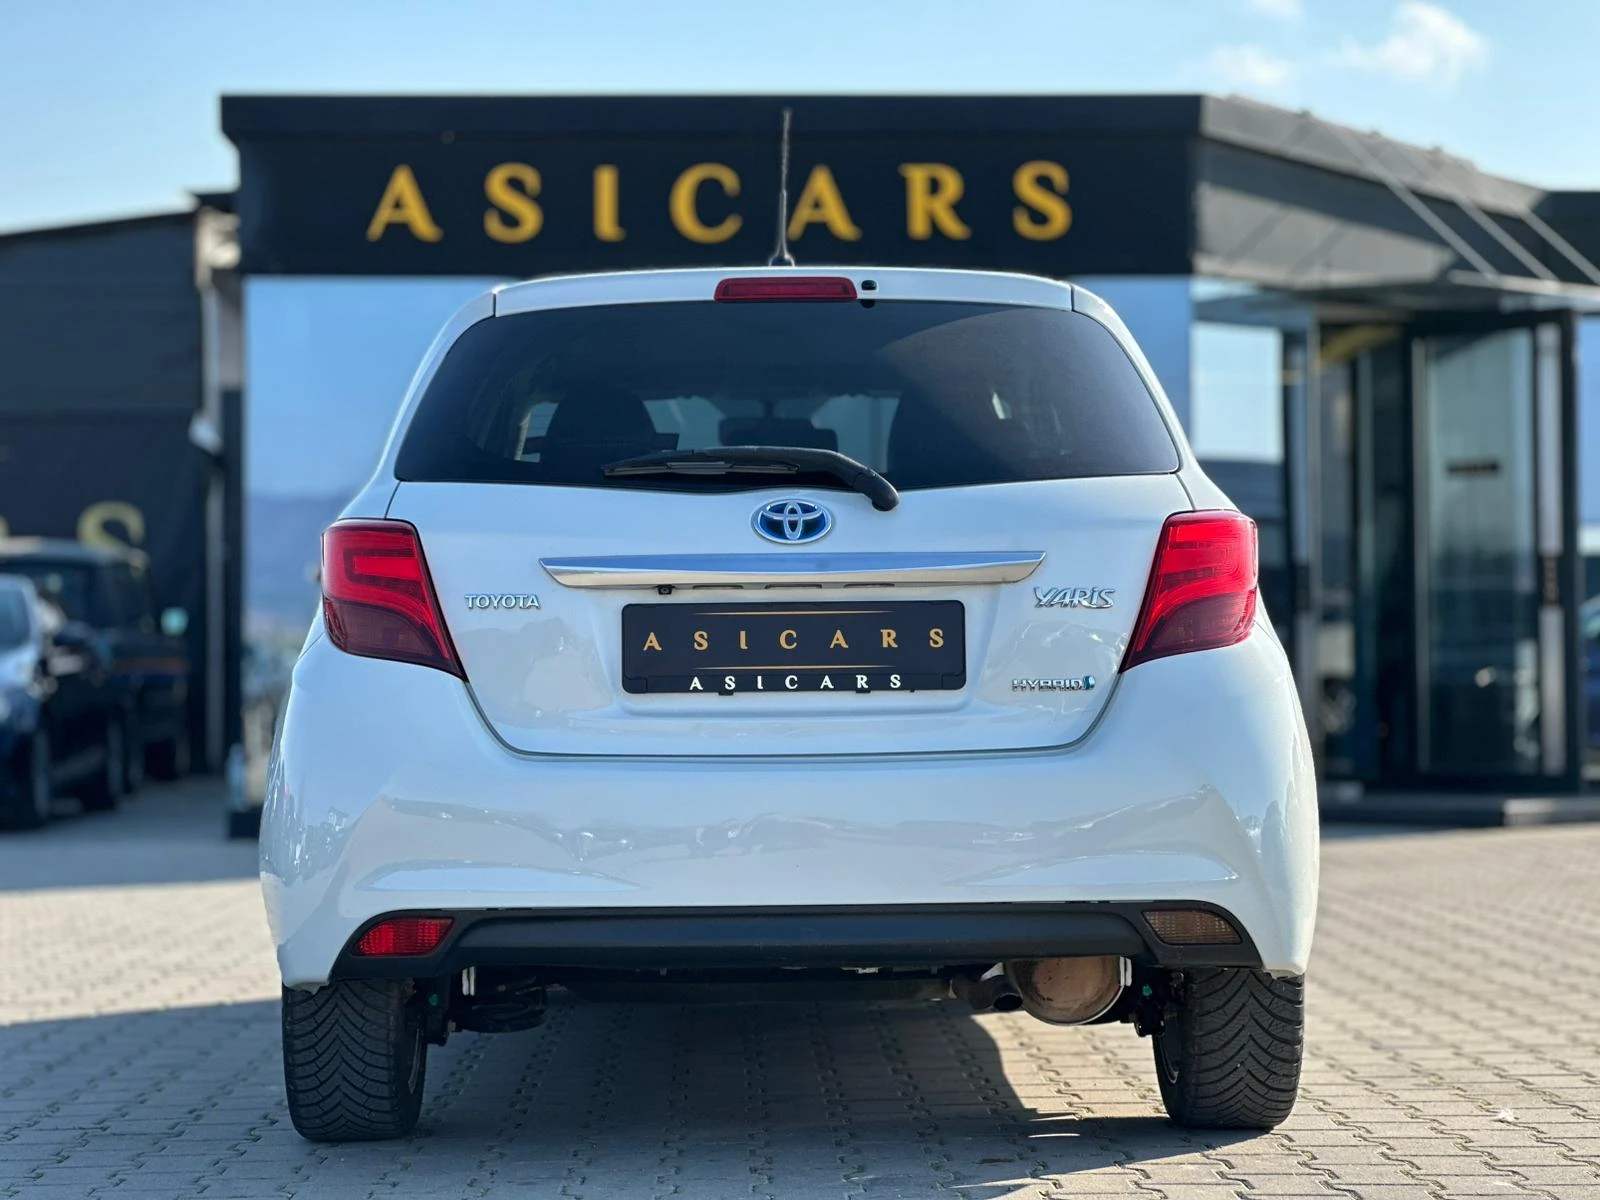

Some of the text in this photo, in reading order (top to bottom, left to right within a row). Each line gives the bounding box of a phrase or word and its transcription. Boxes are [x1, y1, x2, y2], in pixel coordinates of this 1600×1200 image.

[366, 160, 1074, 244] ASICARS
[465, 594, 540, 609] TOYOTA
[643, 628, 945, 651] ASICARS
[689, 674, 902, 691] ASICARS
[1011, 678, 1083, 692] HYBRID
